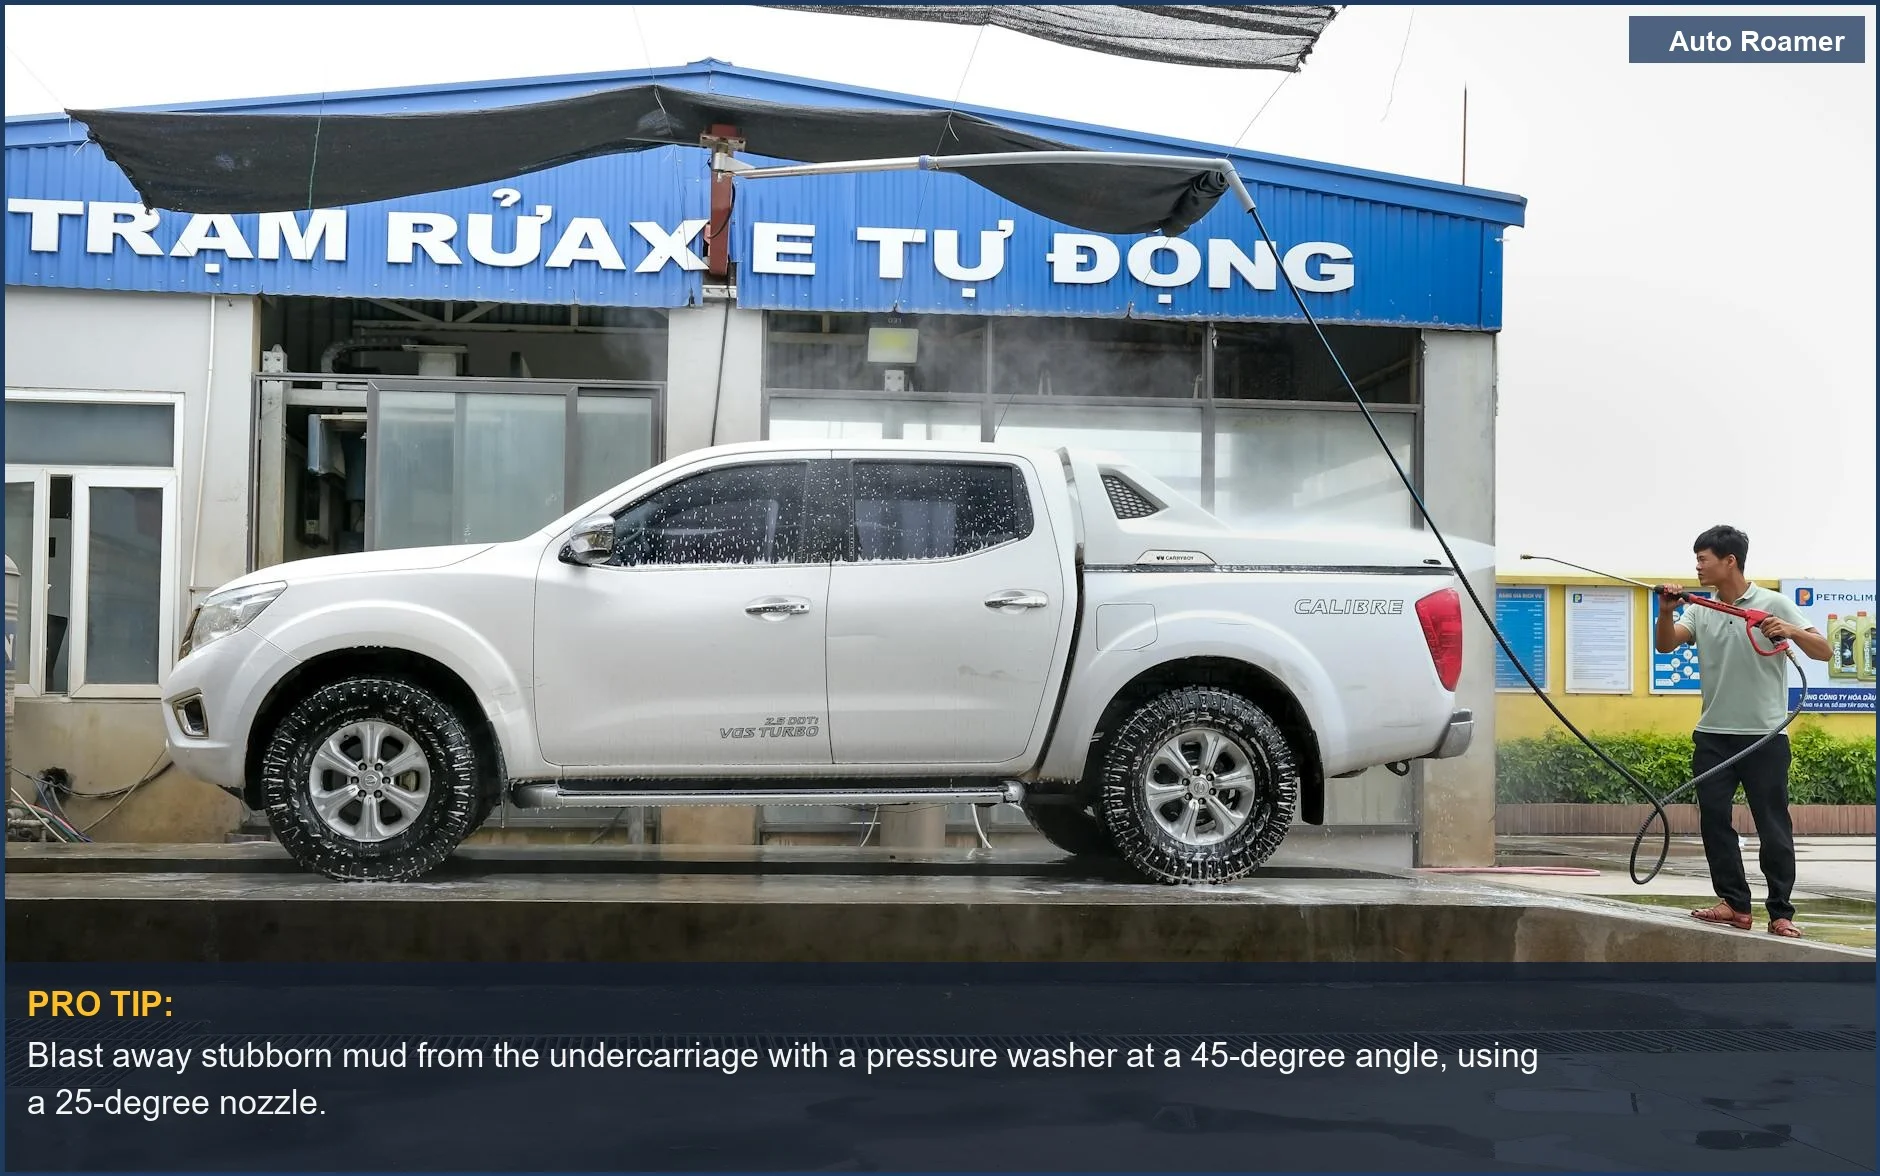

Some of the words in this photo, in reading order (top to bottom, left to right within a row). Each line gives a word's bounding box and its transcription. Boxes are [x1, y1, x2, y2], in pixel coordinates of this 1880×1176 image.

[8, 199, 347, 273] TRẠM
[857, 219, 1014, 298] TỰ
[1816, 593, 1876, 602] PETROLIM
[1295, 598, 1404, 615] CALIBRE
[764, 717, 786, 726] 2.5
[759, 725, 820, 738] TURBO
